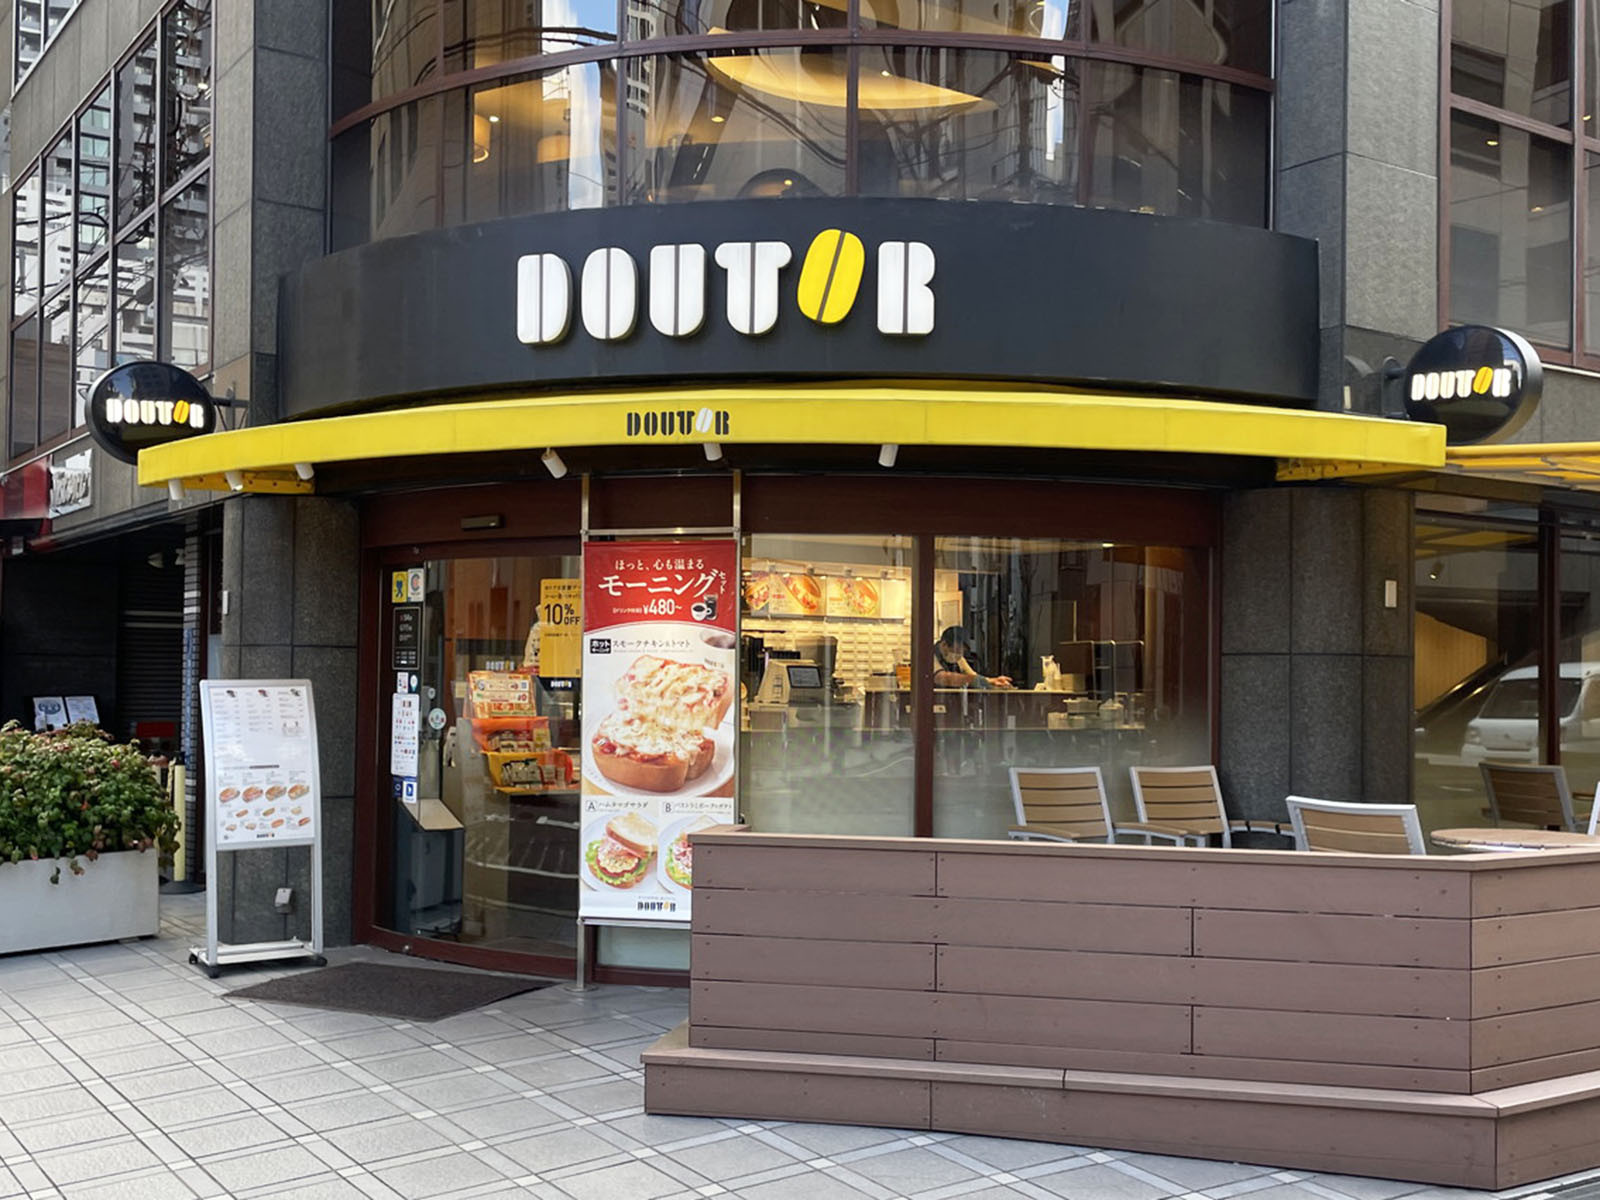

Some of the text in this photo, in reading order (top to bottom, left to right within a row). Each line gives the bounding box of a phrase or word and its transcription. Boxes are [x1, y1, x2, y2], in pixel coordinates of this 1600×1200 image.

[516, 228, 936, 345] DOUTOR
[1410, 366, 1512, 401] DOUTOR
[106, 398, 204, 428] DOUTOR
[626, 407, 730, 436] DOUTOR
[598, 568, 719, 598] モーニング
[719, 570, 727, 595] セット
[564, 616, 580, 625] OFF
